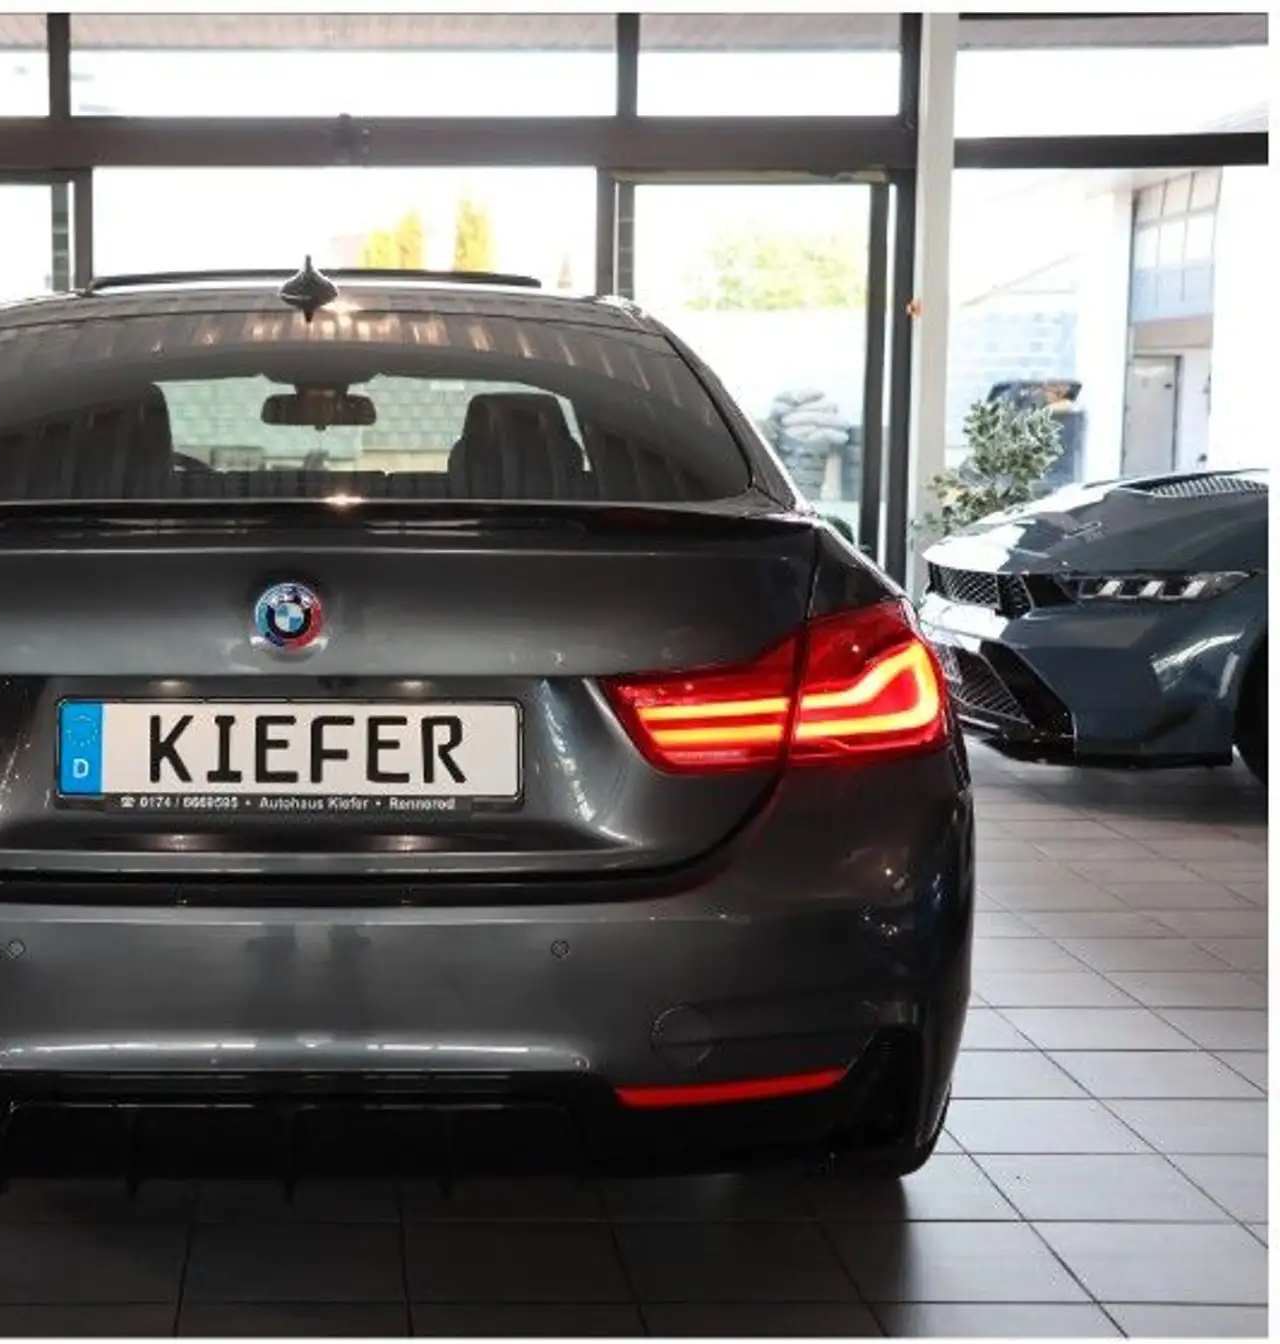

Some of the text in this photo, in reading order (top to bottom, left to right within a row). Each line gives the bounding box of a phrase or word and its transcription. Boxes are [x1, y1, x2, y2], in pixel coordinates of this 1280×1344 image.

[148, 714, 467, 784] KIEFER
[72, 759, 89, 778] D
[259, 796, 325, 811] Autohaus
[328, 796, 369, 810] Kiefer
